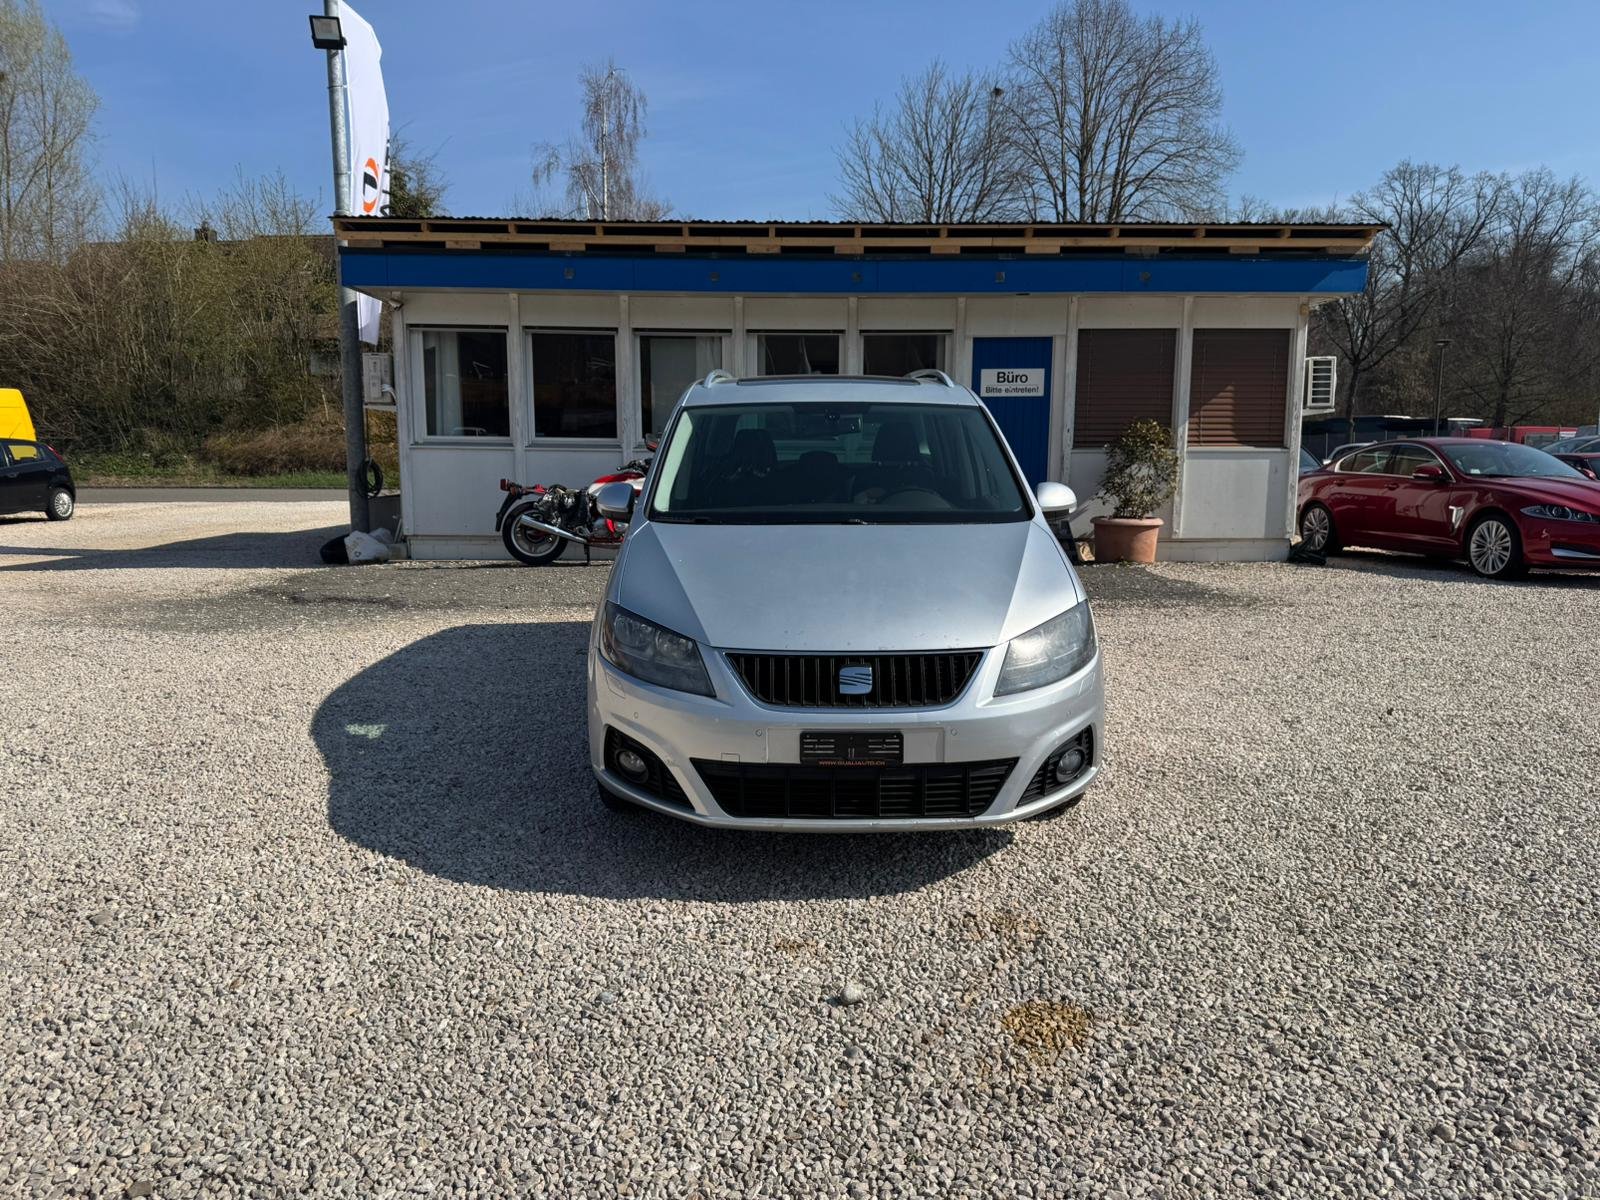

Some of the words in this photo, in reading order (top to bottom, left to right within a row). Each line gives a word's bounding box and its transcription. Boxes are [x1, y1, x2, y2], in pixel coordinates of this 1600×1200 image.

[996, 371, 1029, 384] Büro
[985, 386, 1002, 394] Bitte
[1004, 386, 1039, 394] eintreten!
